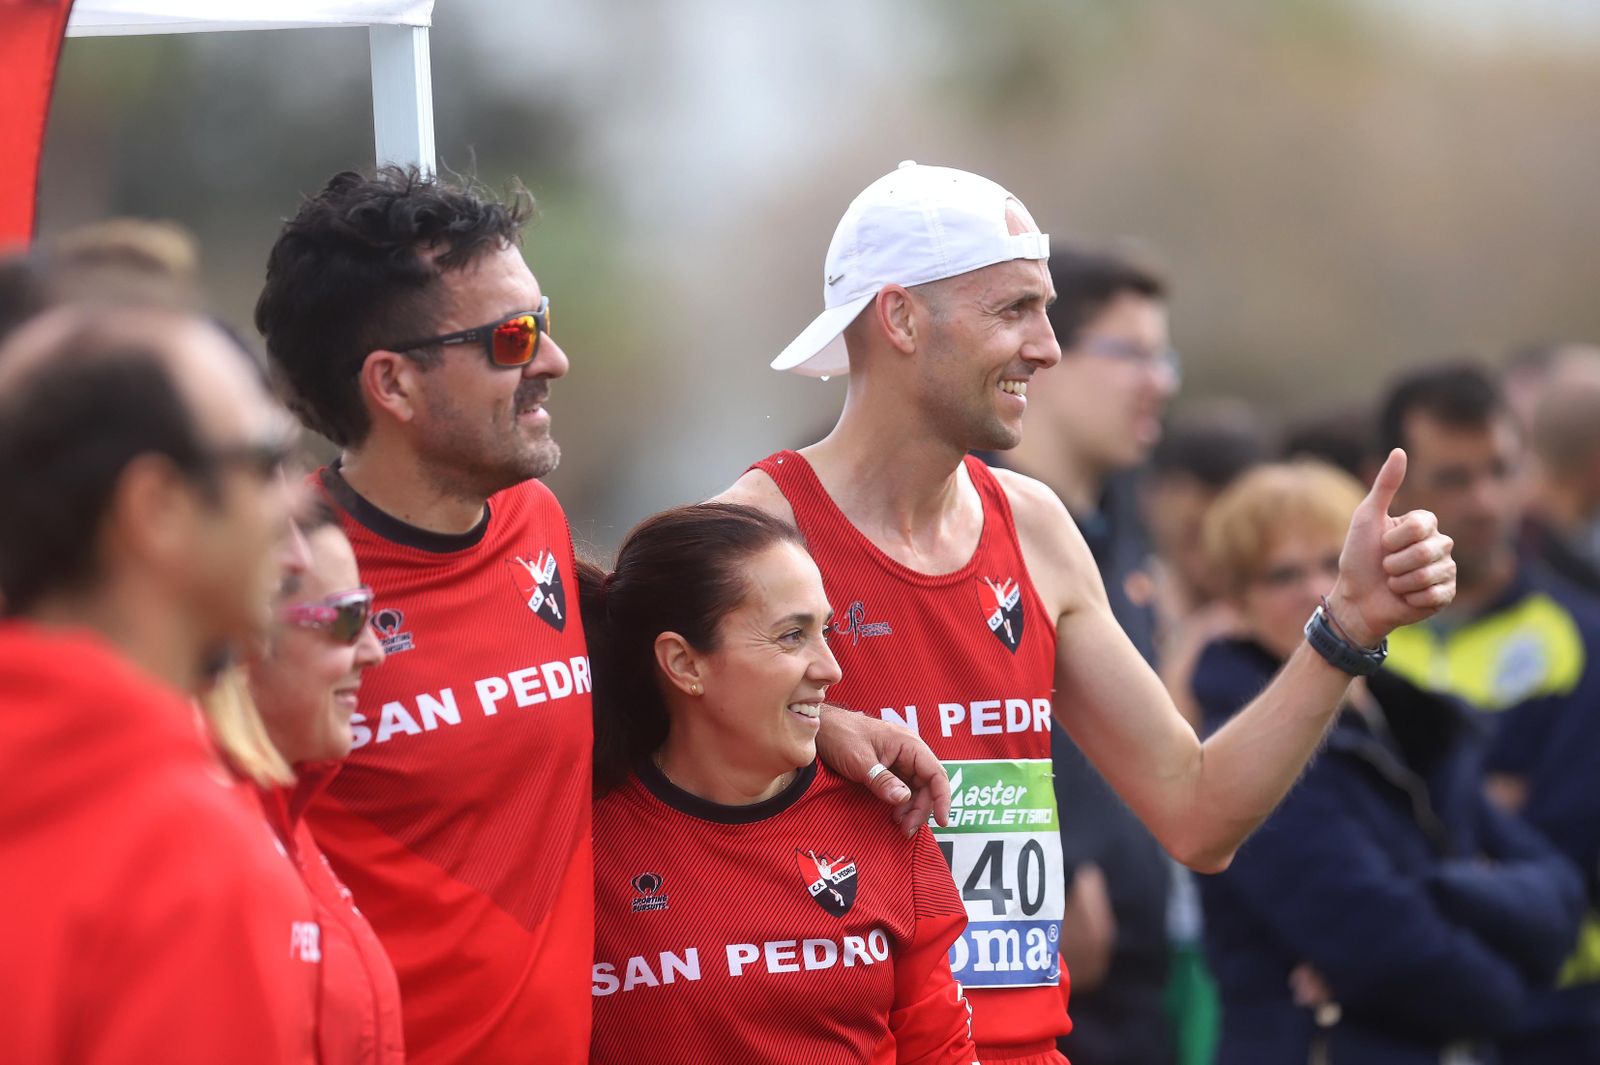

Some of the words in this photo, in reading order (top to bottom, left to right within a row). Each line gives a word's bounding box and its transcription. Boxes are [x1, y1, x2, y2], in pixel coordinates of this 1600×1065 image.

[474, 656, 592, 717] PEDR
[632, 894, 668, 906] SPORTING
[591, 947, 702, 996] SAN
[725, 928, 889, 977] PEDRO
